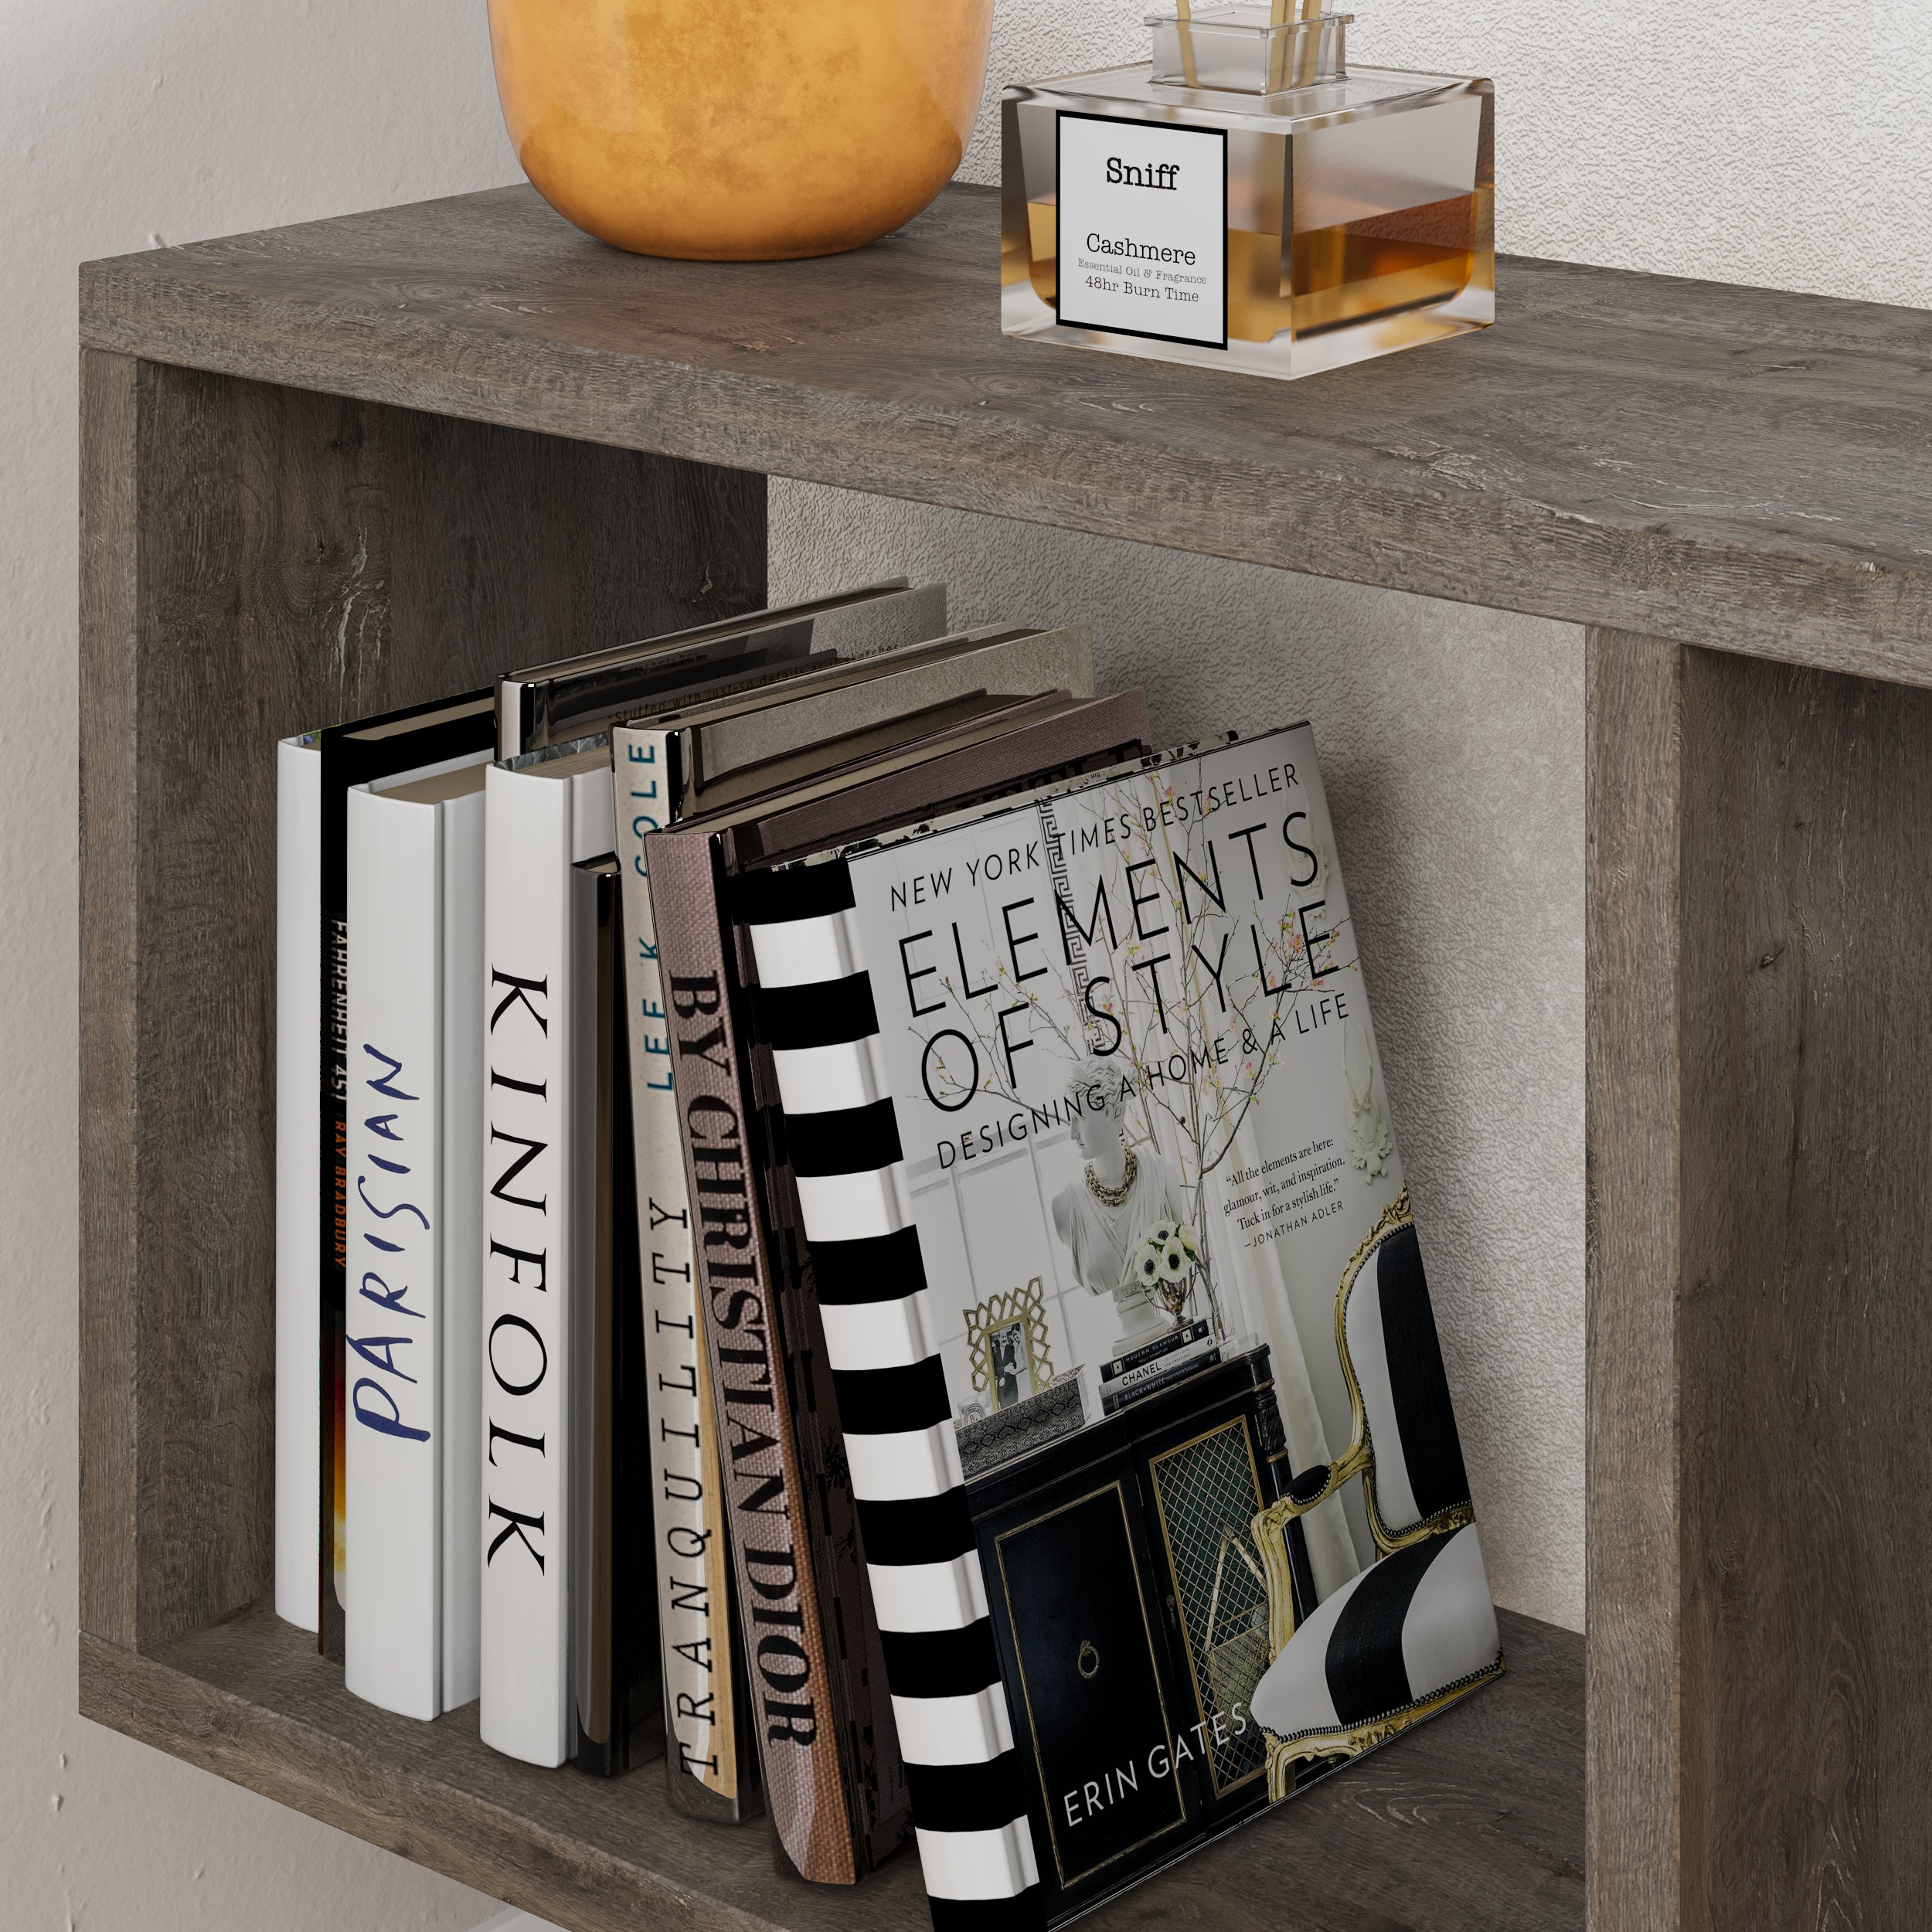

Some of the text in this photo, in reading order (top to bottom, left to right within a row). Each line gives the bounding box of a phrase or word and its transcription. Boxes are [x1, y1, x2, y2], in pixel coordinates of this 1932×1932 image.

[1107, 157, 1180, 190] Sniff
[1078, 258, 1207, 284] Essential Oil & Fragrance
[1086, 275, 1199, 302] 48hr Burn Time
[1087, 233, 1196, 265] Cashmere
[890, 867, 952, 912] NEW
[966, 841, 1039, 886] YORK
[1052, 813, 1131, 859] TIMES
[1142, 764, 1299, 832] BESTSELLER
[898, 811, 1319, 1019] ELEMENTS
[330, 919, 347, 1102] FAHRENHEIT 451
[921, 900, 1340, 1112] OF STYLE
[937, 992, 1350, 1170] DESIGNING A HOME & A LIFE
[334, 1121, 347, 1269] RAY BRADBURY
[1223, 1158, 1345, 1216] glamour, wit, and inspiration.
[1226, 1138, 1334, 1186] “All the elements are here:
[1237, 1178, 1339, 1230] Tuck in for a stylish life.”
[1311, 1200, 1344, 1223] ADLER
[345, 1043, 431, 1443] PARISIAN
[487, 962, 548, 1577] KINFOLK
[668, 969, 818, 1748] BY CHRISTIAN DIOR
[1122, 1362, 1162, 1386] CHANEL
[1125, 1335, 1179, 1362] MODERN GLAMOUR
[649, 1196, 719, 1777] TRANQUILITY
[1063, 1702, 1247, 1827] ERIN GATES
